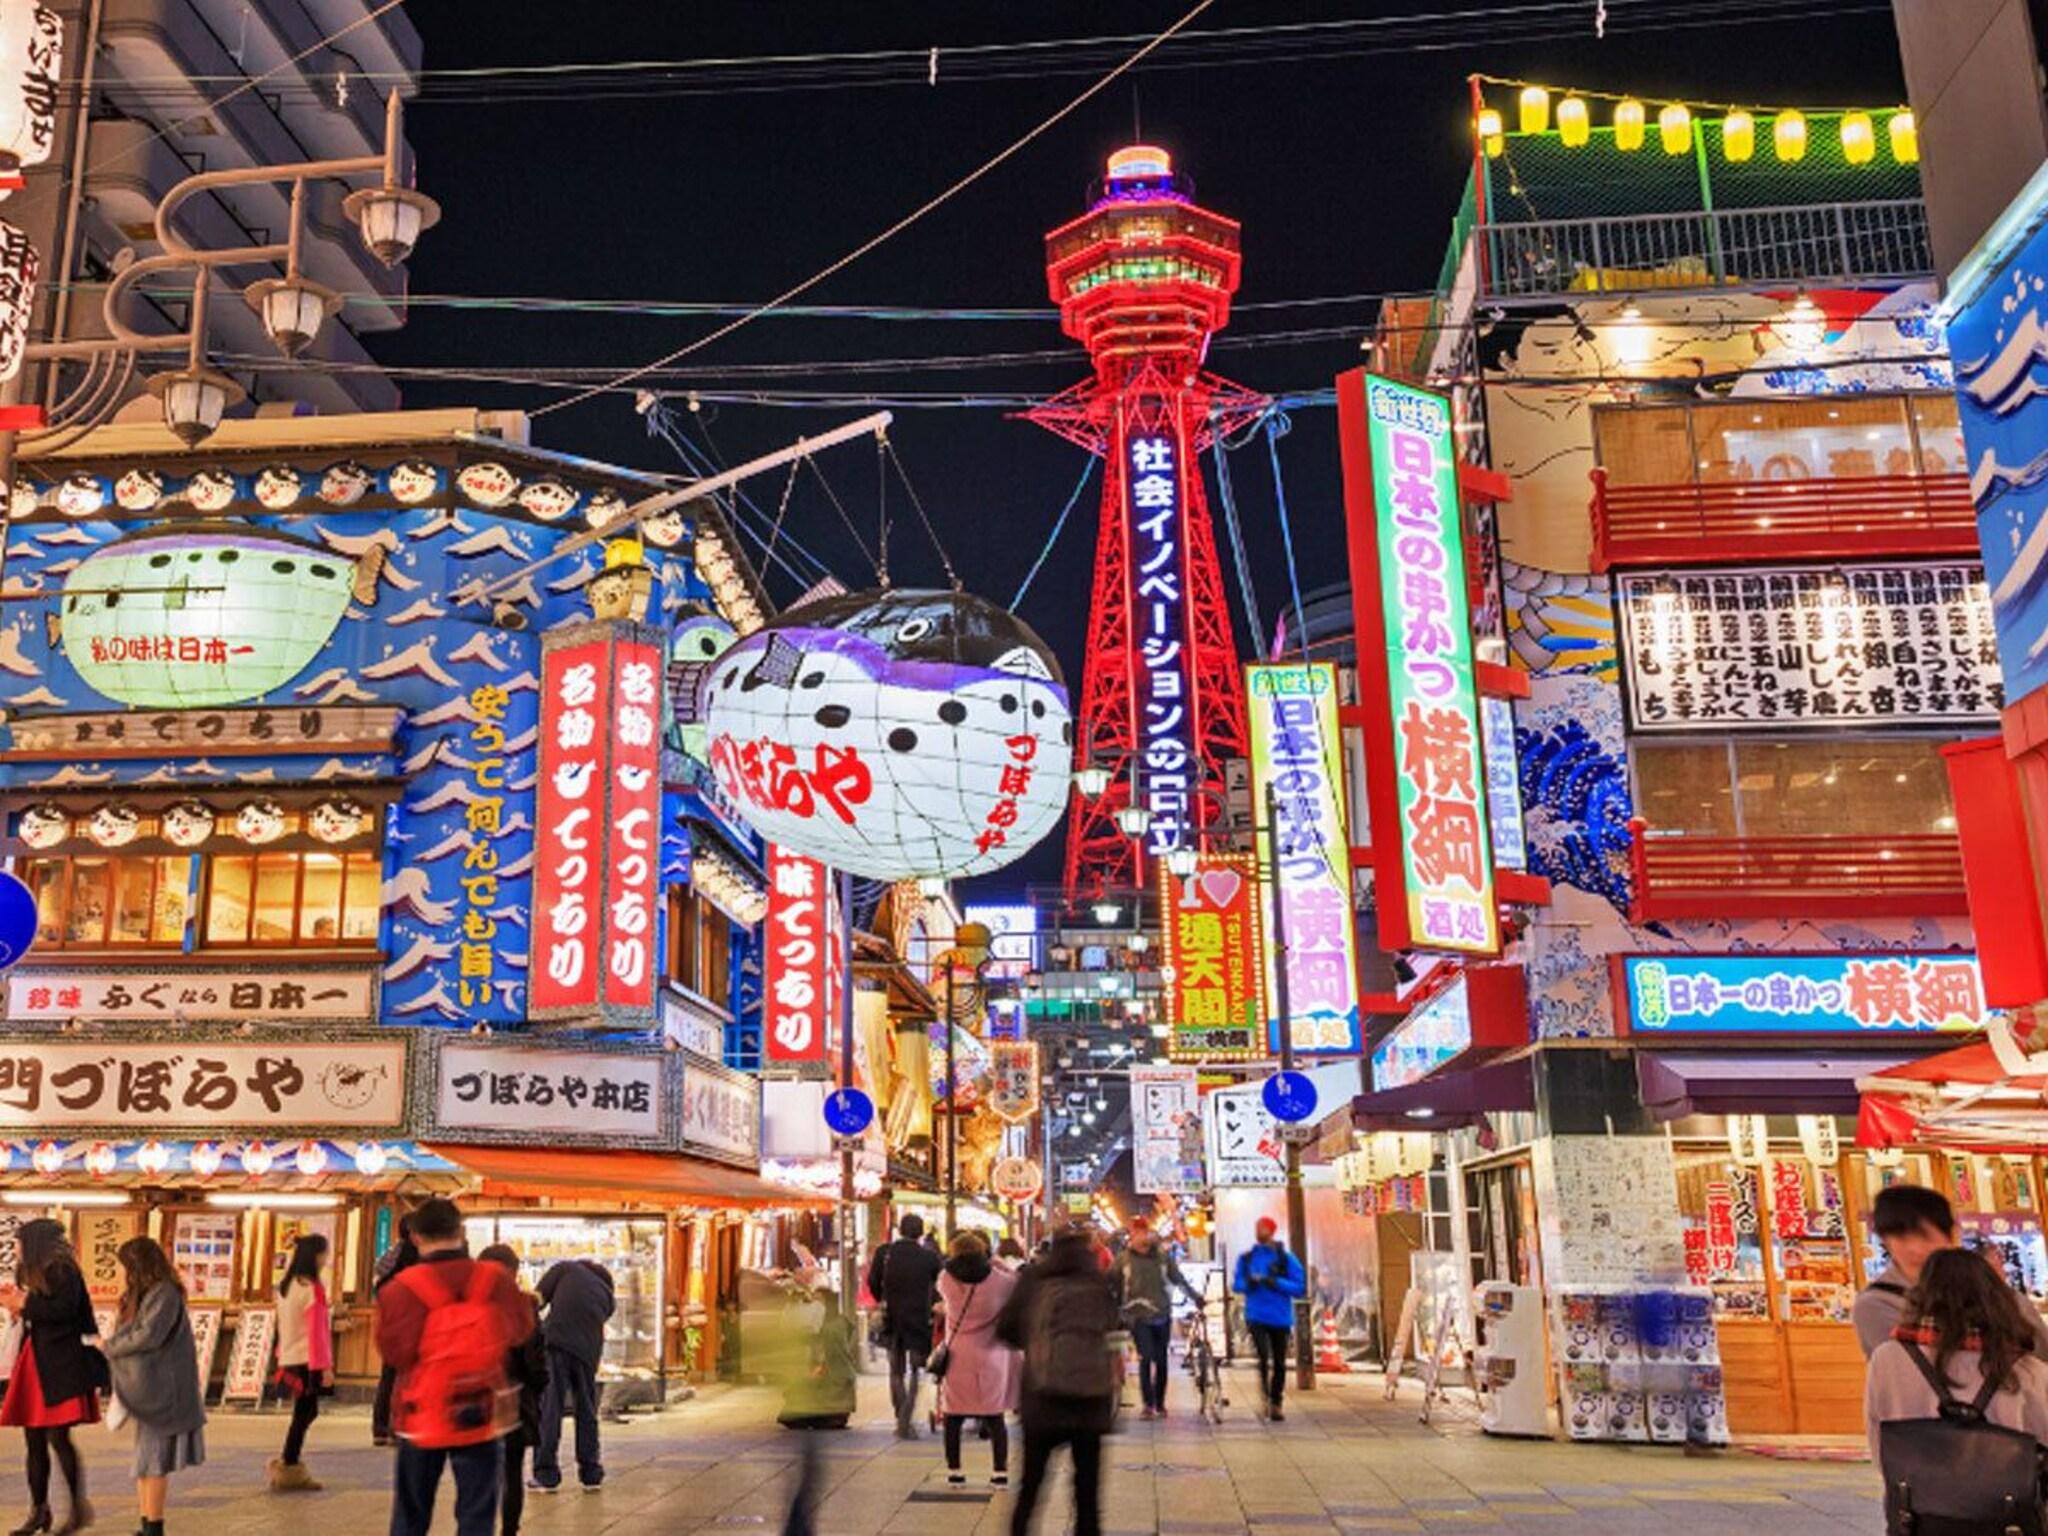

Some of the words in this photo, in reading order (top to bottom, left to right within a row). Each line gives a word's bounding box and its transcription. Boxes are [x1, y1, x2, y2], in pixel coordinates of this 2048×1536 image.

[1393, 433, 1455, 699] 日本一の串かつ
[92, 637, 255, 663] 私の味は日本一
[1132, 439, 1190, 855] 社会イノベーションの日立
[1720, 647, 1751, 716] にんにく
[1750, 645, 1778, 716] 玉ねぎ
[1835, 643, 1868, 713] れんこん
[1400, 701, 1484, 892] 横綱
[1424, 900, 1487, 941] 酒処
[1178, 912, 1229, 1026] 通天閣
[1226, 914, 1247, 1024] TSUTENKAKU
[1668, 977, 1842, 1012] 日本一の串かつ
[1846, 961, 1982, 1025] 横綱
[451, 1070, 650, 1113] づぼらや本店
